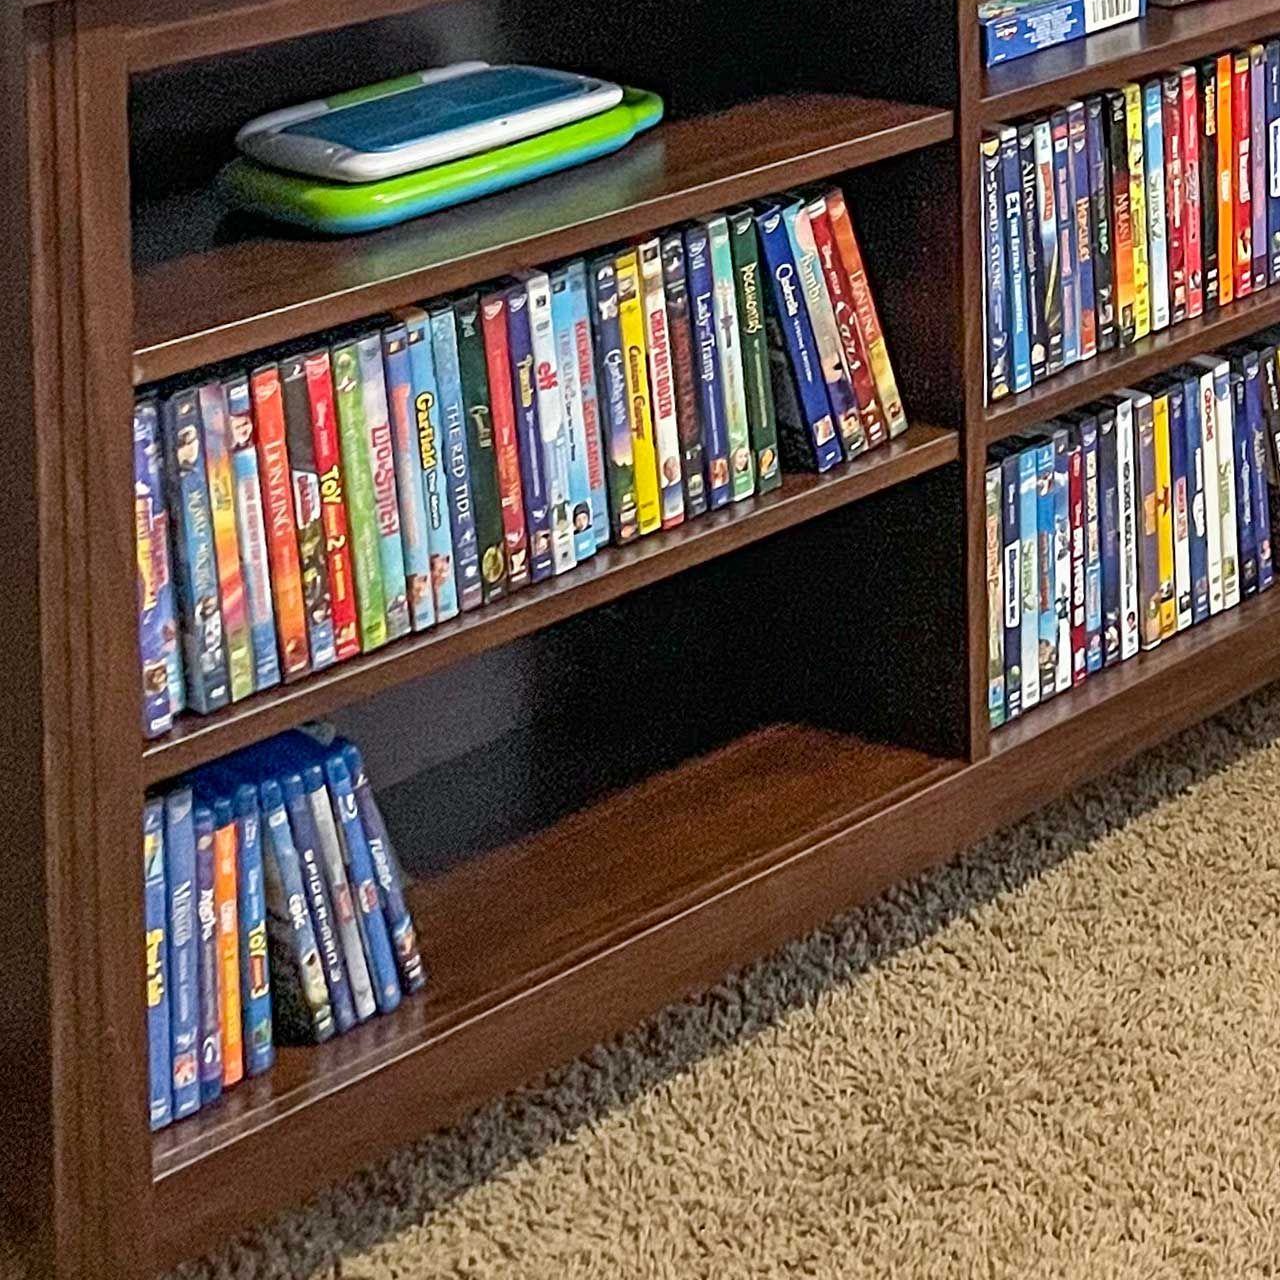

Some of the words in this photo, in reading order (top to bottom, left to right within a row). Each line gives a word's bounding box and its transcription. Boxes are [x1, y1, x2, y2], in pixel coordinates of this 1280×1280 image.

[987, 181, 1000, 231] SWORD
[1021, 159, 1036, 210] Alice
[739, 262, 761, 335] POCAHONTAS
[800, 252, 821, 303] Bambi
[695, 291, 712, 327] Lady
[649, 308, 670, 367] CHEAPER
[700, 334, 716, 382] Tramp
[446, 402, 462, 438] THE
[657, 377, 673, 420] DOZEN
[414, 391, 438, 470] Garfield
[450, 444, 467, 478] RED
[320, 465, 343, 504] TOY
[454, 482, 472, 525] TIDE
[326, 535, 346, 551] 2
[304, 848, 338, 966] SPIDER-MAN
[330, 967, 342, 983] 3
[249, 922, 269, 957] TOY
